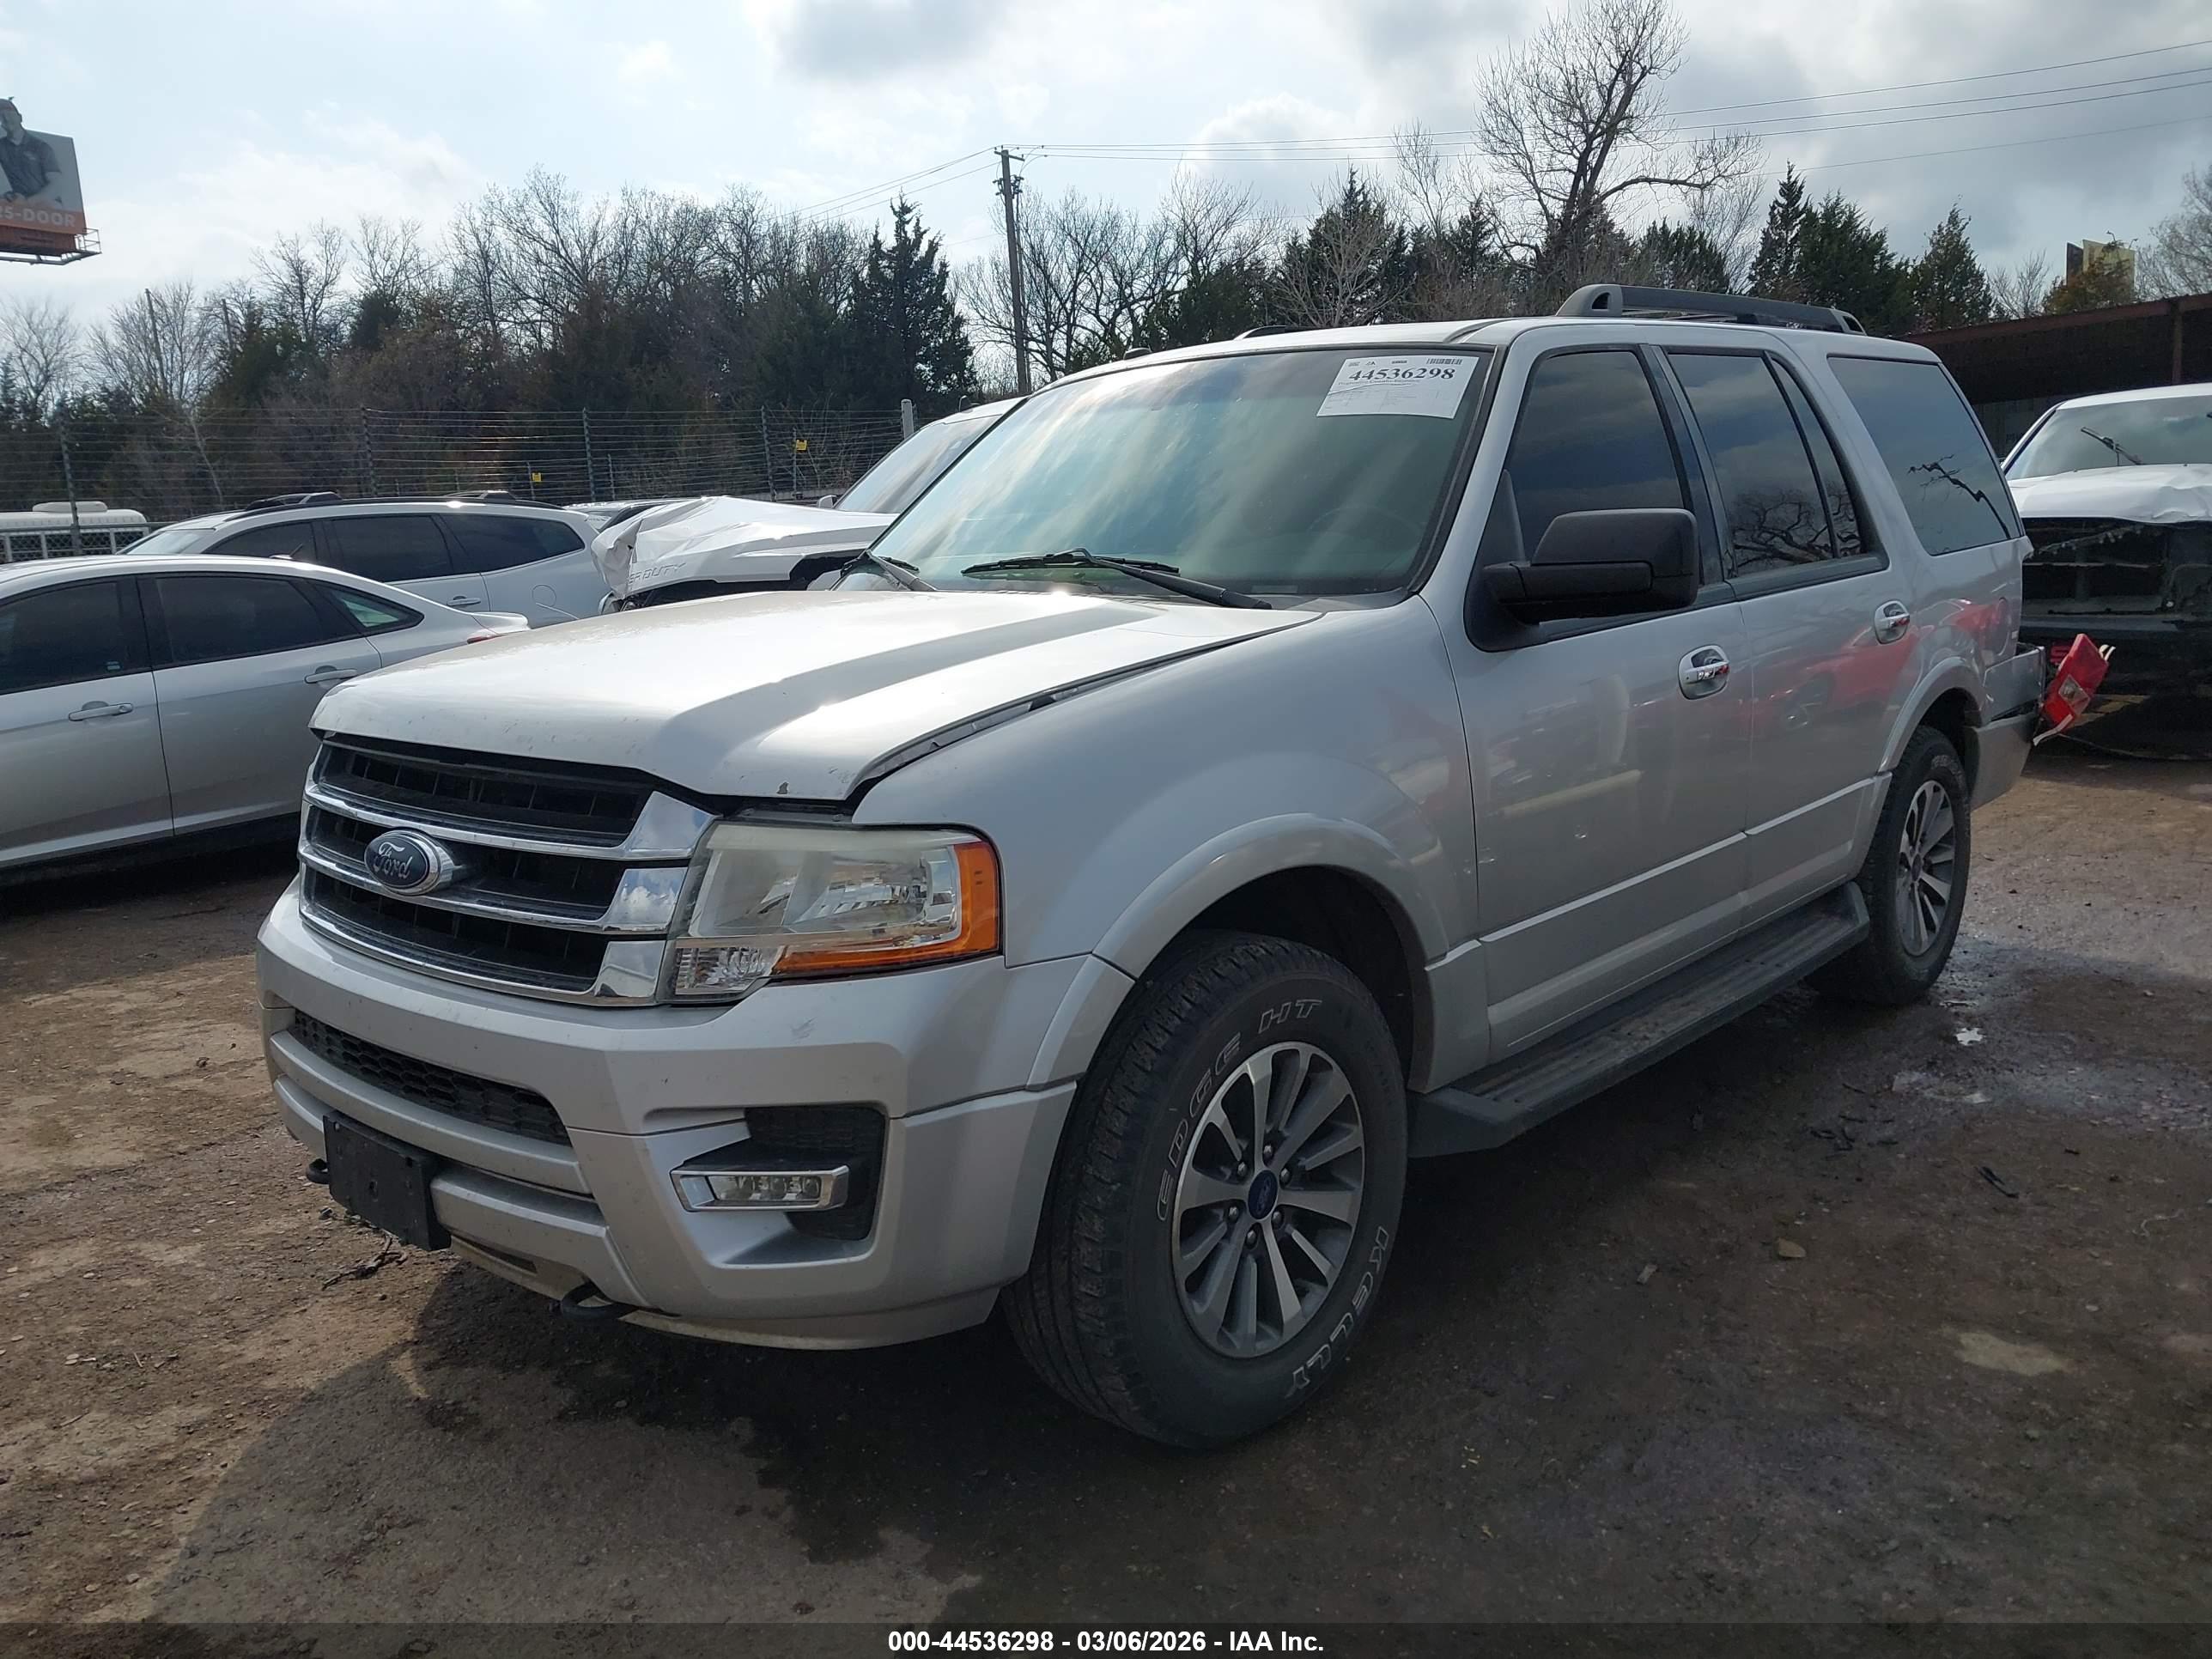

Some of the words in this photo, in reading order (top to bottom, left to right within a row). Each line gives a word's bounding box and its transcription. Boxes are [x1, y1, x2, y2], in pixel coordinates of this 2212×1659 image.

[1349, 368, 1455, 380] 44536298
[642, 562, 686, 580] DUTY
[374, 842, 413, 879] Ford
[1156, 1033, 1241, 1220] EDGE
[1258, 1000, 1322, 1034] HT
[1285, 1226, 1389, 1399] KELLY
